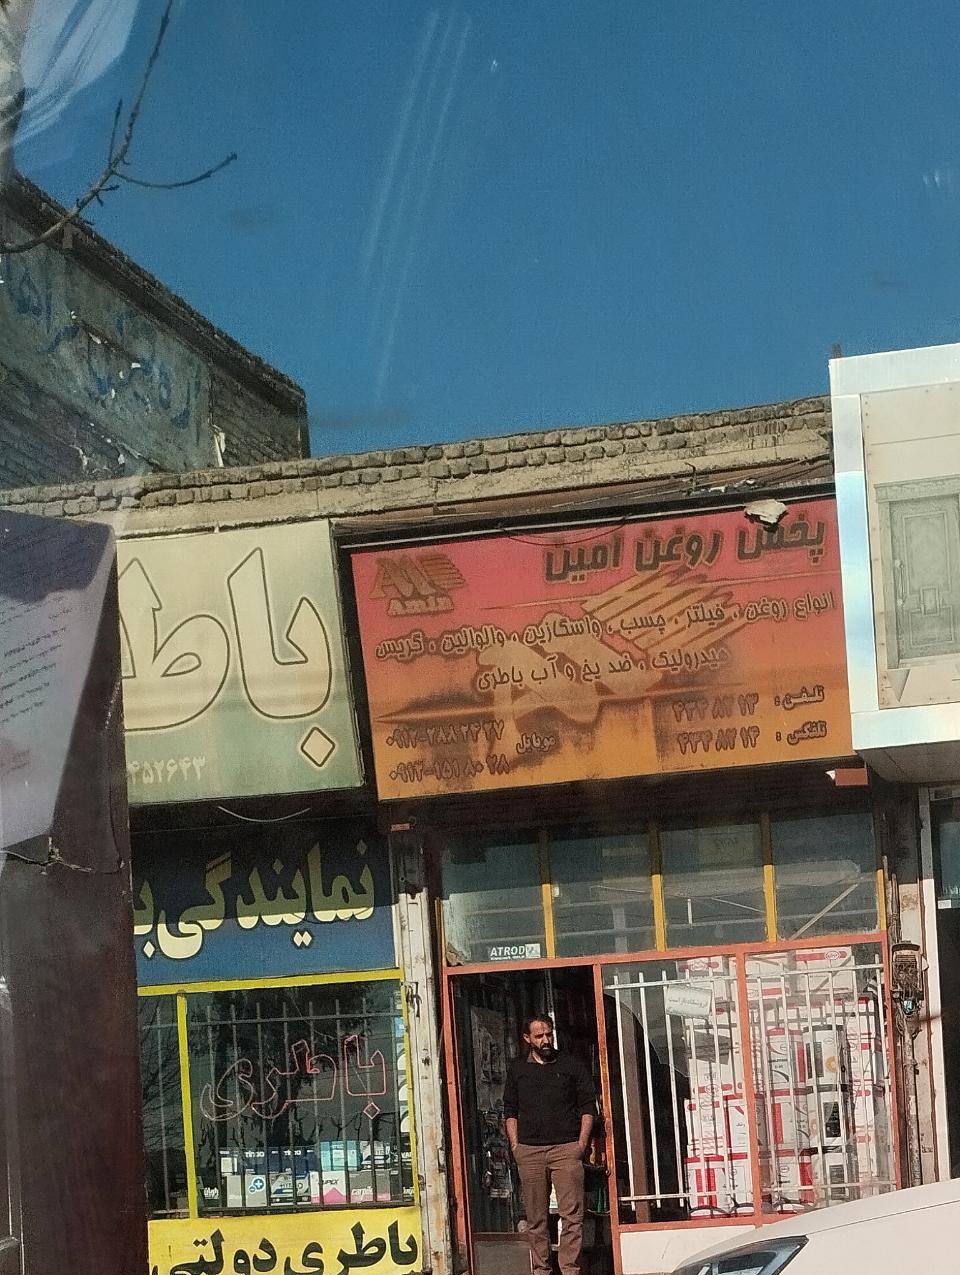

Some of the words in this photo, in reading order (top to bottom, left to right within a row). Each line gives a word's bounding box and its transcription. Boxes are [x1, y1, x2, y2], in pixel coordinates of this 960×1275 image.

[544, 534, 624, 584] امین
[634, 524, 723, 573] روغن
[685, 602, 726, 629] فیلتر
[744, 598, 789, 623] روغن
[793, 590, 837, 620] انواع
[619, 615, 667, 635] چسب
[117, 546, 336, 768] باط
[530, 654, 558, 684] آب
[581, 657, 601, 683] یخ
[607, 651, 633, 674] ضد
[651, 646, 732, 673] هیدرولیک
[477, 664, 525, 692] باطری
[563, 663, 577, 682] و
[156, 840, 376, 960] نمایندگی
[200, 1034, 388, 1121] باطری
